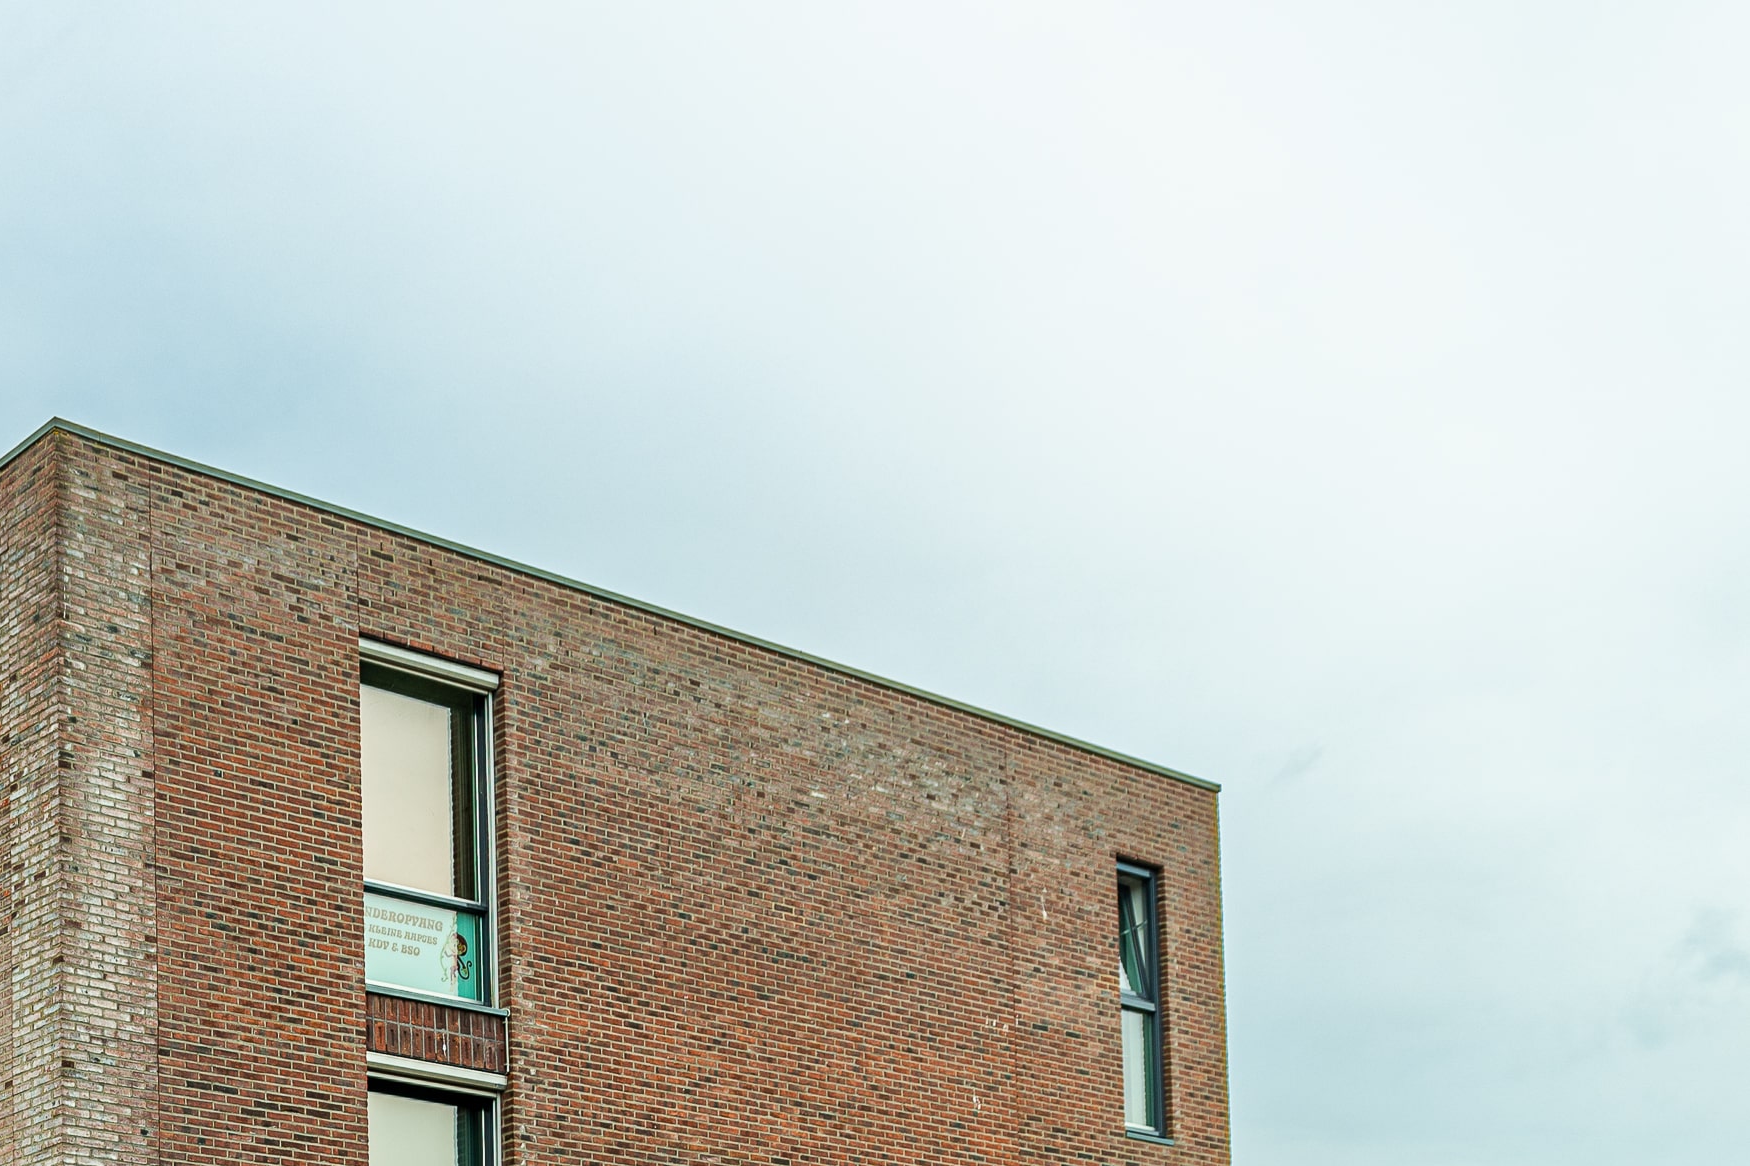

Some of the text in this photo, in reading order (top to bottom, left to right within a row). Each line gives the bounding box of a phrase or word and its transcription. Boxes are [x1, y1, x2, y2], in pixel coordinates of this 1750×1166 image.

[368, 924, 403, 939] KLEINE
[368, 938, 421, 956] KDV & BSO
